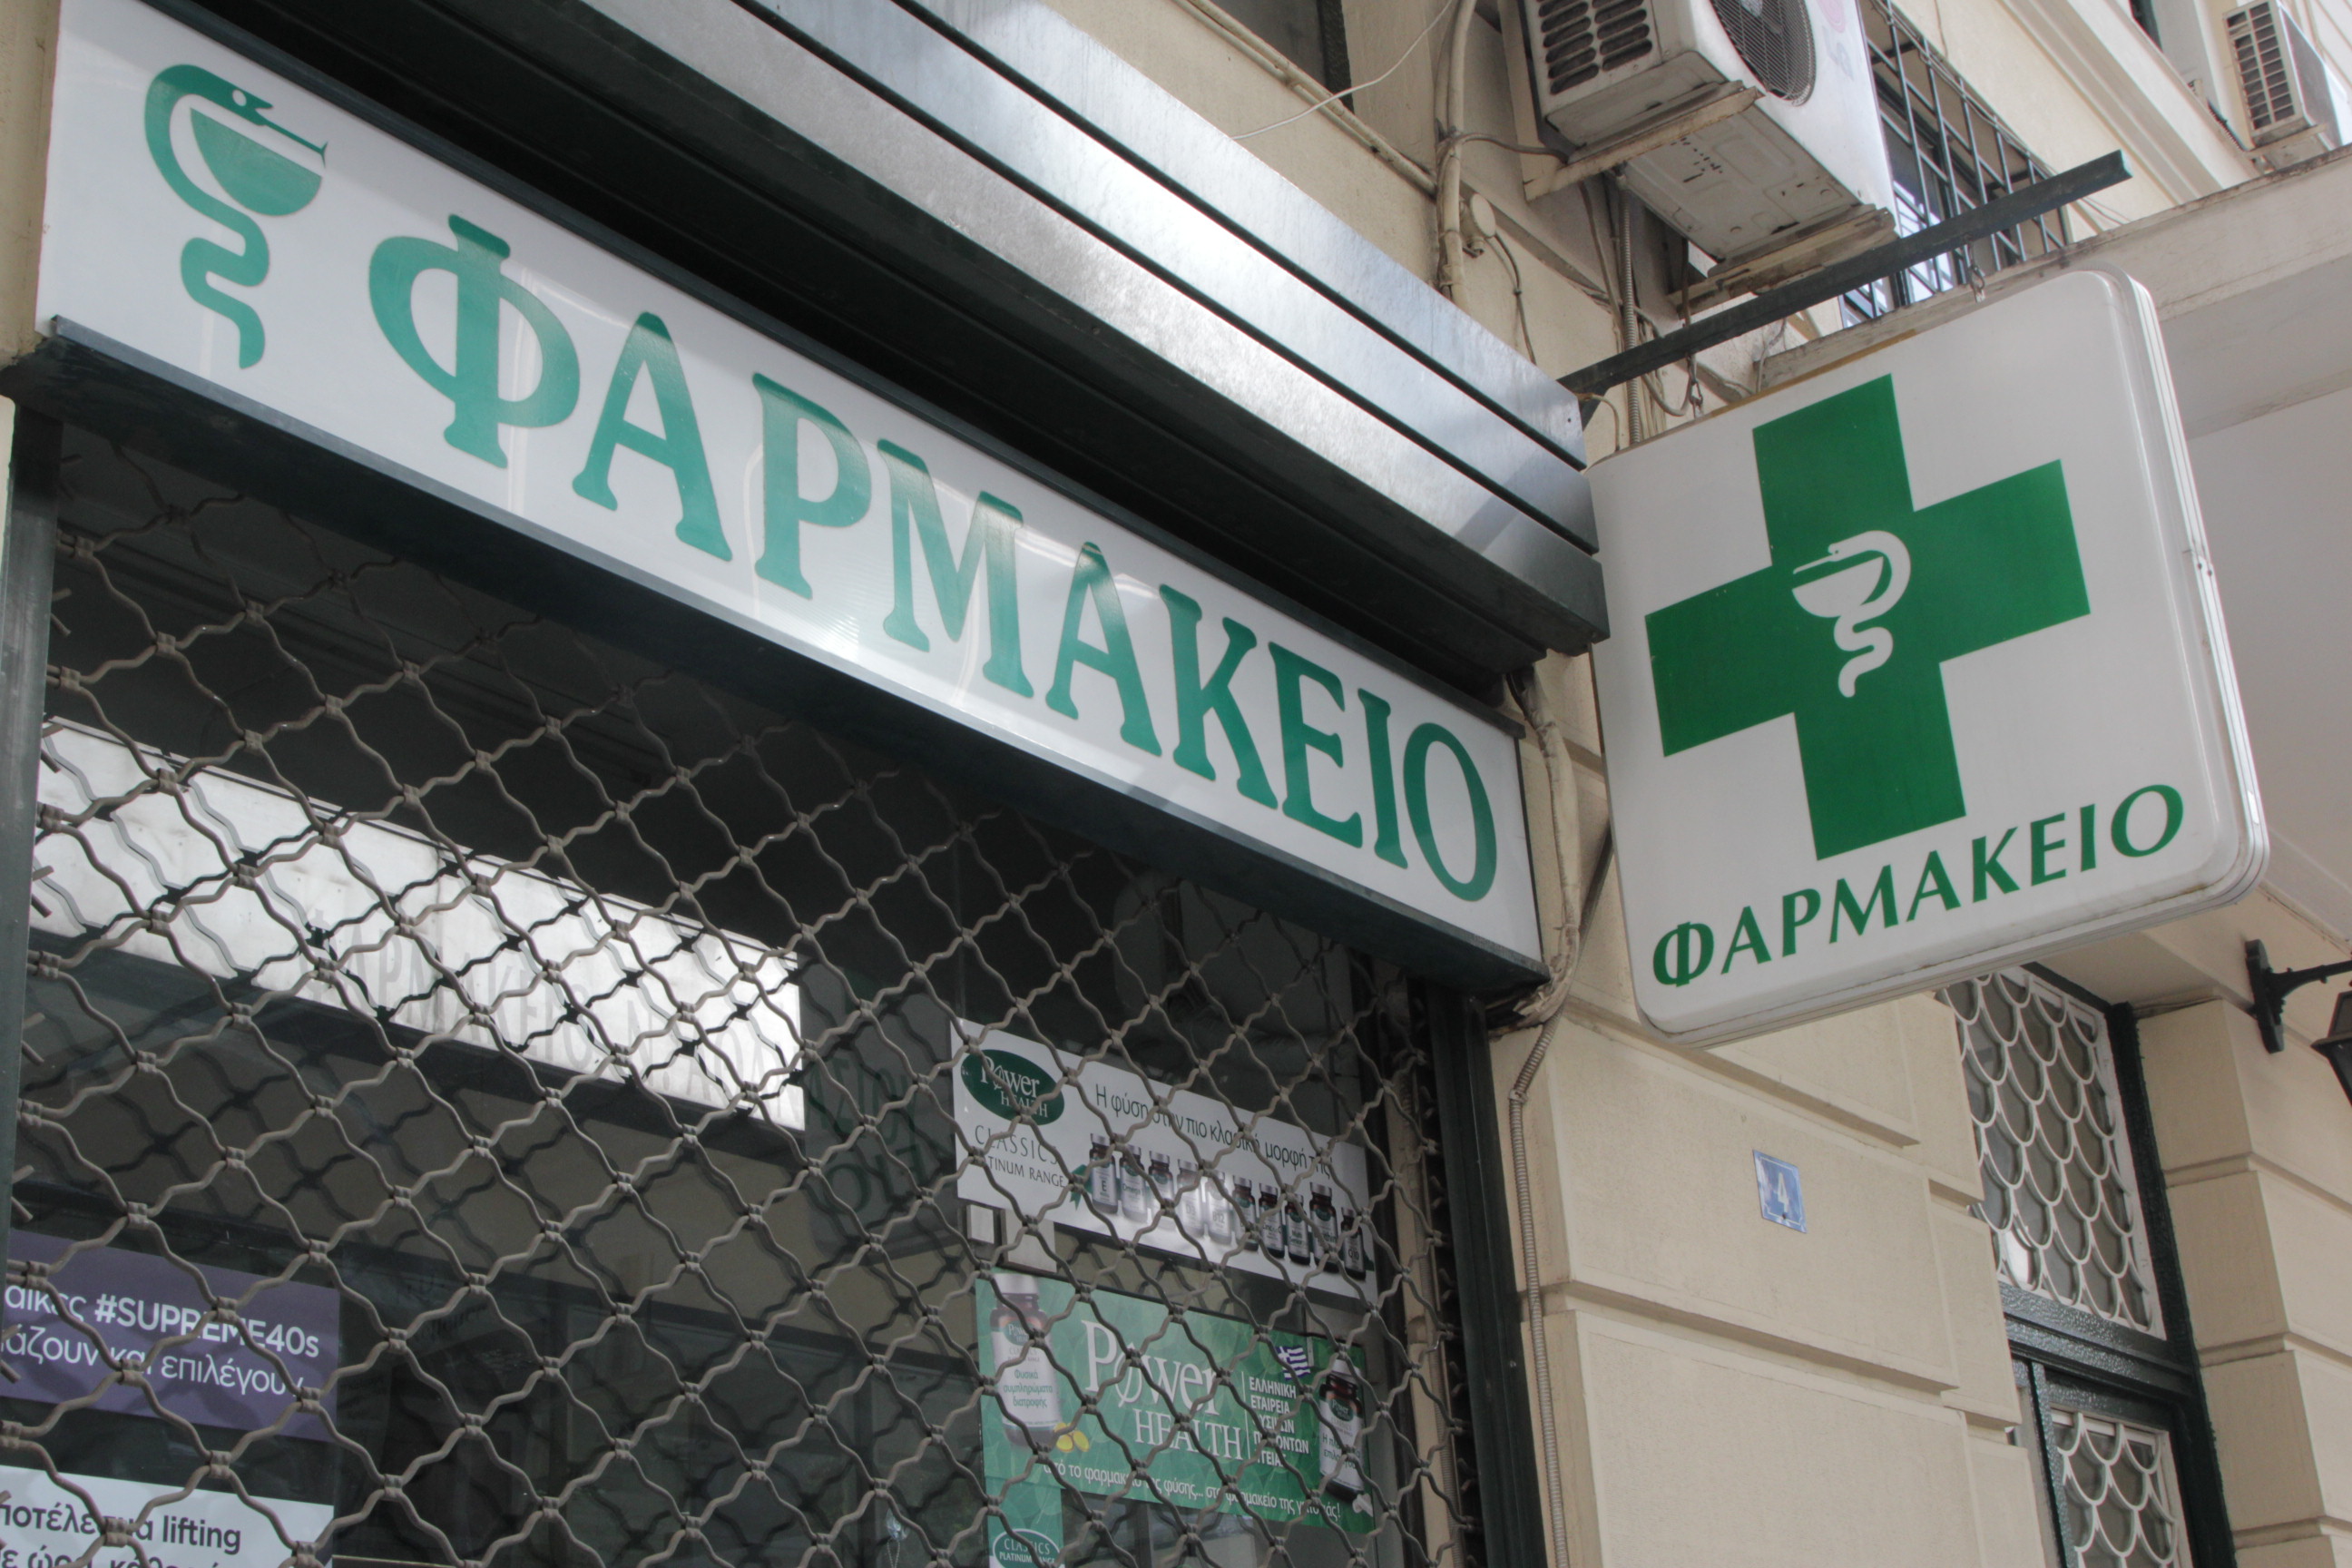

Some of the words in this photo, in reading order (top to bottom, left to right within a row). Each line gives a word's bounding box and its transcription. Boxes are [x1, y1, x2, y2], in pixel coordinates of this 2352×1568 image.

[368, 214, 1496, 901] ΦΑΡΜΑΚΕΙΟ
[1652, 784, 2184, 987] ΦΑΡΜΑΚΕΙΟ
[1096, 1083, 1107, 1108] Η
[1112, 1092, 1149, 1122] φύση
[1186, 1117, 1208, 1139] πιο
[1266, 1143, 1308, 1171] μορφή
[1029, 1167, 1065, 1188] RANGE
[1771, 1171, 1789, 1214] 4
[1014, 1369, 1038, 1380] Φυσικά
[1081, 1319, 1220, 1416] Power
[1249, 1376, 1297, 1399] ΕΛΛΗΝΙΚΗ
[1250, 1395, 1290, 1415] ΕΤΑΙΡΕΙΑ
[1253, 1414, 1295, 1434] ΥΣΙΩΝ
[1068, 1465, 1082, 1478] το
[1084, 1467, 1142, 1488] φαρμακο
[1279, 1497, 1296, 1516] της
[162, 1514, 241, 1555] lifting
[999, 1551, 1032, 1563] PLATINUM
